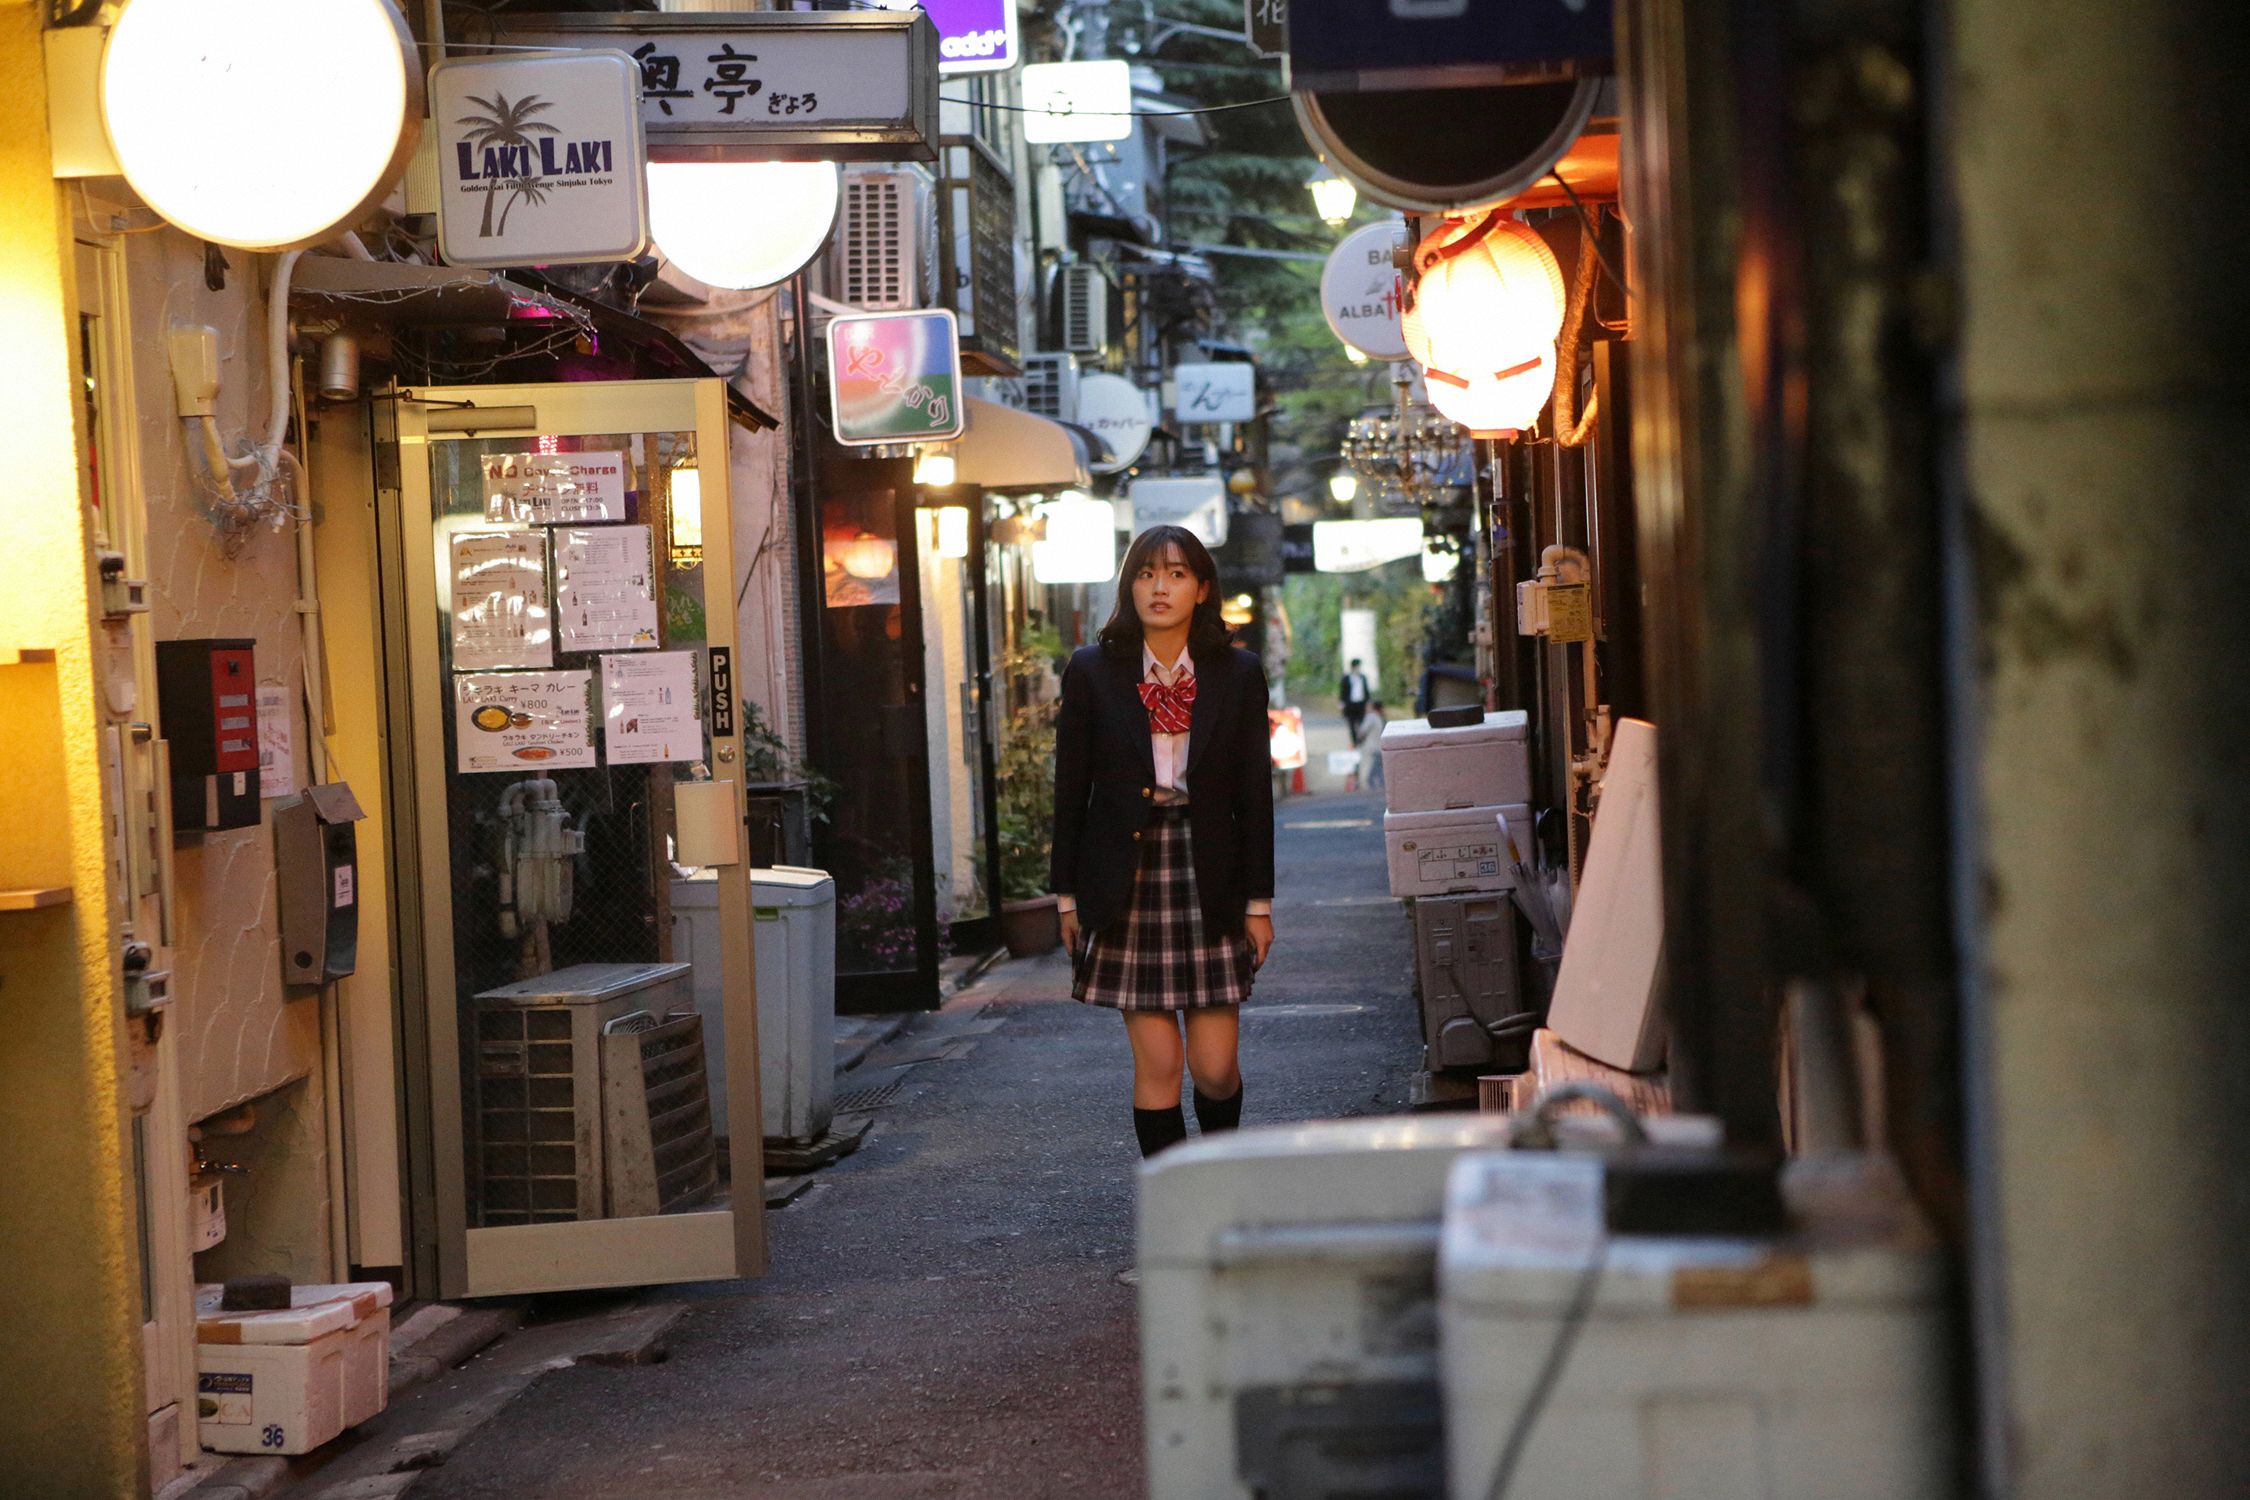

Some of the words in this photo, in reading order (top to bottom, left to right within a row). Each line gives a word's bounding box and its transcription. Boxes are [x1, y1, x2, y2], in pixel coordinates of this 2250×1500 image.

[768, 91, 818, 115] ぎょろ
[457, 142, 530, 180] LAKI
[539, 137, 613, 176] LAKI
[460, 183, 489, 193] Golden
[490, 183, 504, 191] Gai
[556, 179, 587, 189] Sinjuku
[589, 178, 613, 187] Tokyo
[1368, 250, 1393, 265] BA
[489, 465, 518, 479] NO
[523, 467, 569, 478] Cov
[569, 465, 617, 476] Charge
[509, 683, 540, 694] キーマ
[546, 682, 577, 694] カレー
[713, 655, 729, 728] PUSH
[499, 694, 518, 704] Curry
[520, 699, 548, 710] ¥800
[560, 748, 583, 757] ¥500
[1480, 863, 1496, 873] 36
[262, 1427, 284, 1448] 36
